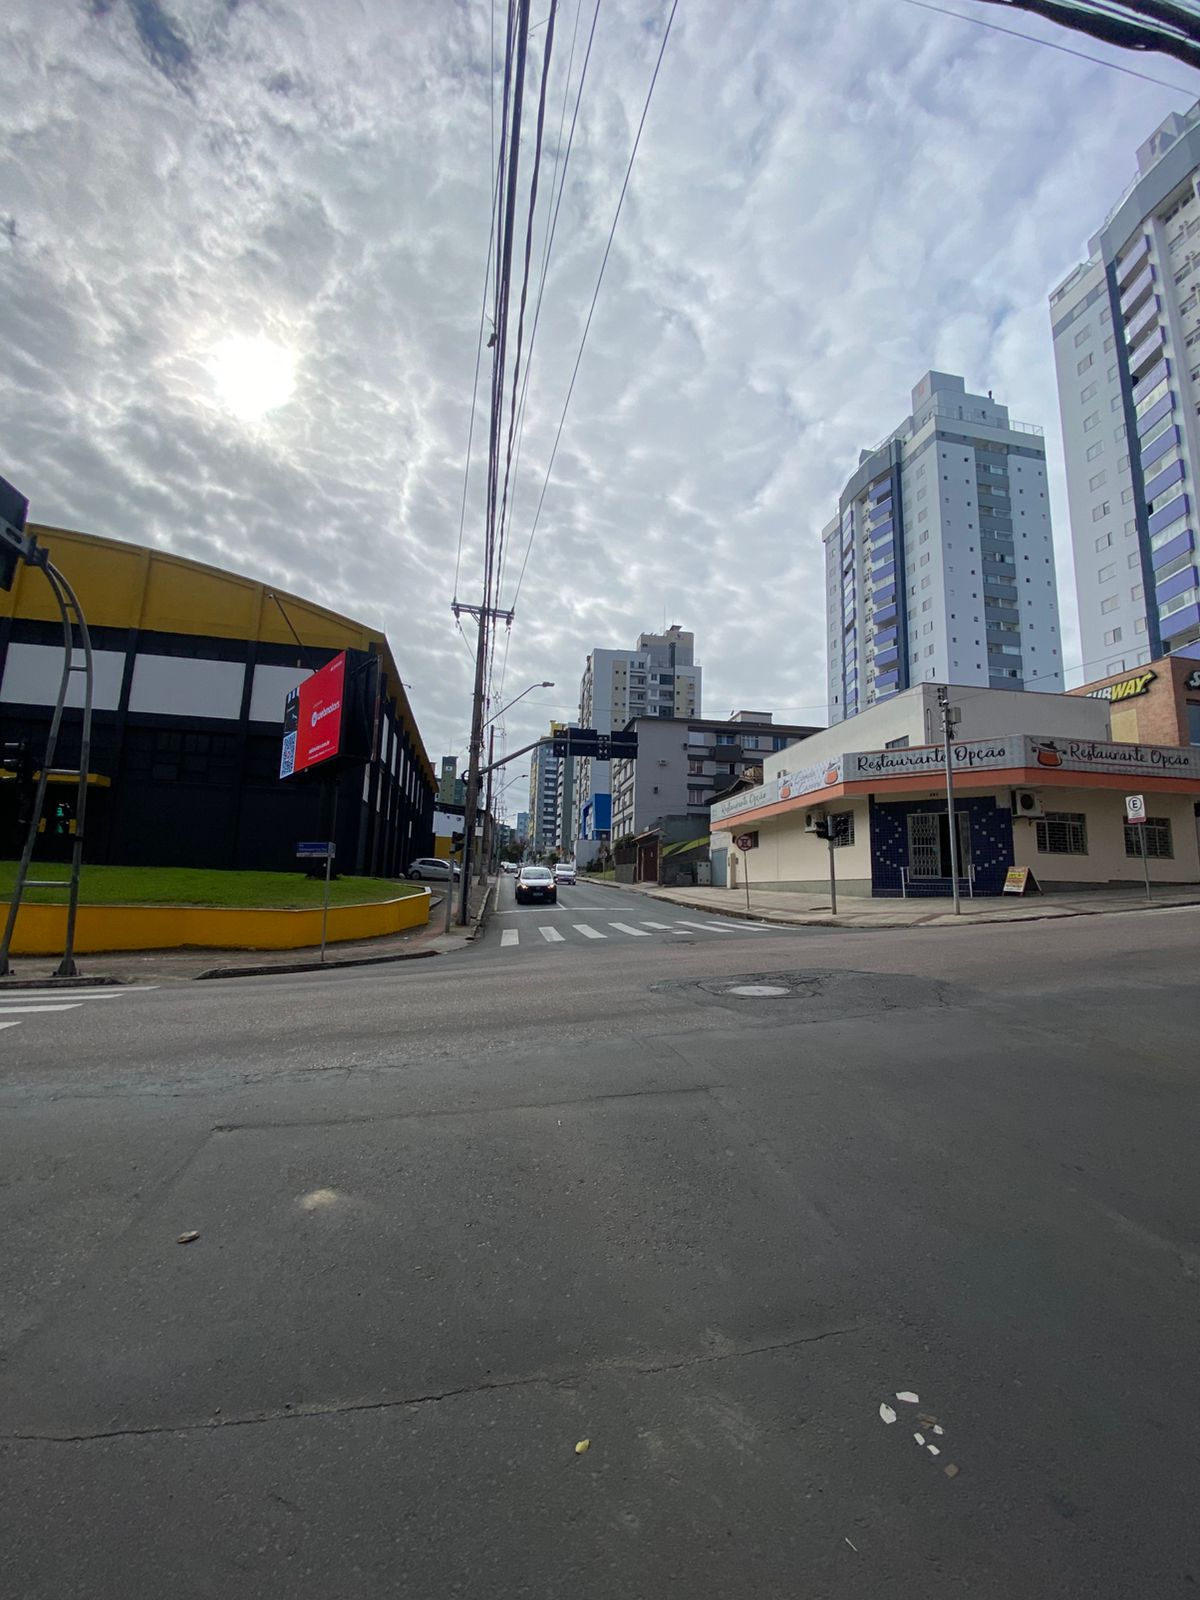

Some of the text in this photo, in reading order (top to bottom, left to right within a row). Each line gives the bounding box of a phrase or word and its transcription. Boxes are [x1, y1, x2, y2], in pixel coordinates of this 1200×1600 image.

[857, 745, 1006, 771] Restaurante Opção
[1069, 741, 1190, 768] Restaurante Opção
